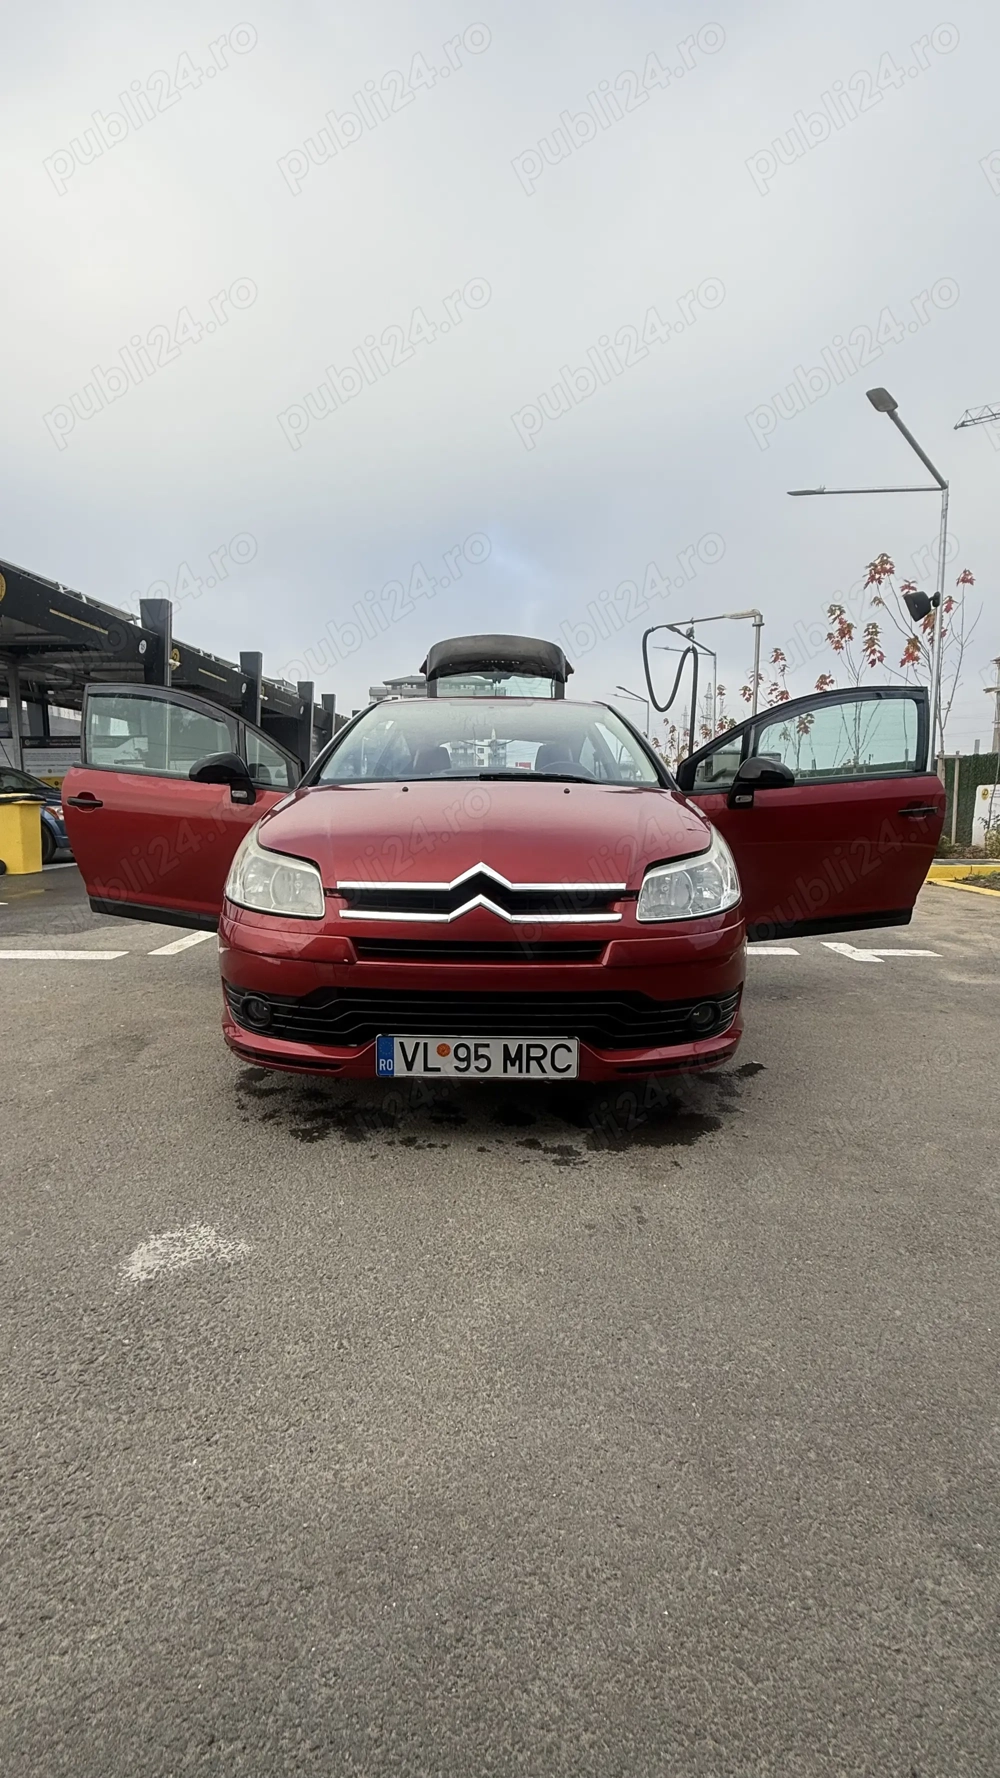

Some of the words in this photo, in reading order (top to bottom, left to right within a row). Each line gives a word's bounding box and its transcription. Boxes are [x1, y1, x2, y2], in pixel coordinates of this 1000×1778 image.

[379, 1059, 393, 1071] RO
[399, 1041, 441, 1073] VL
[453, 1042, 492, 1073] 95
[502, 1043, 573, 1074] MRC
